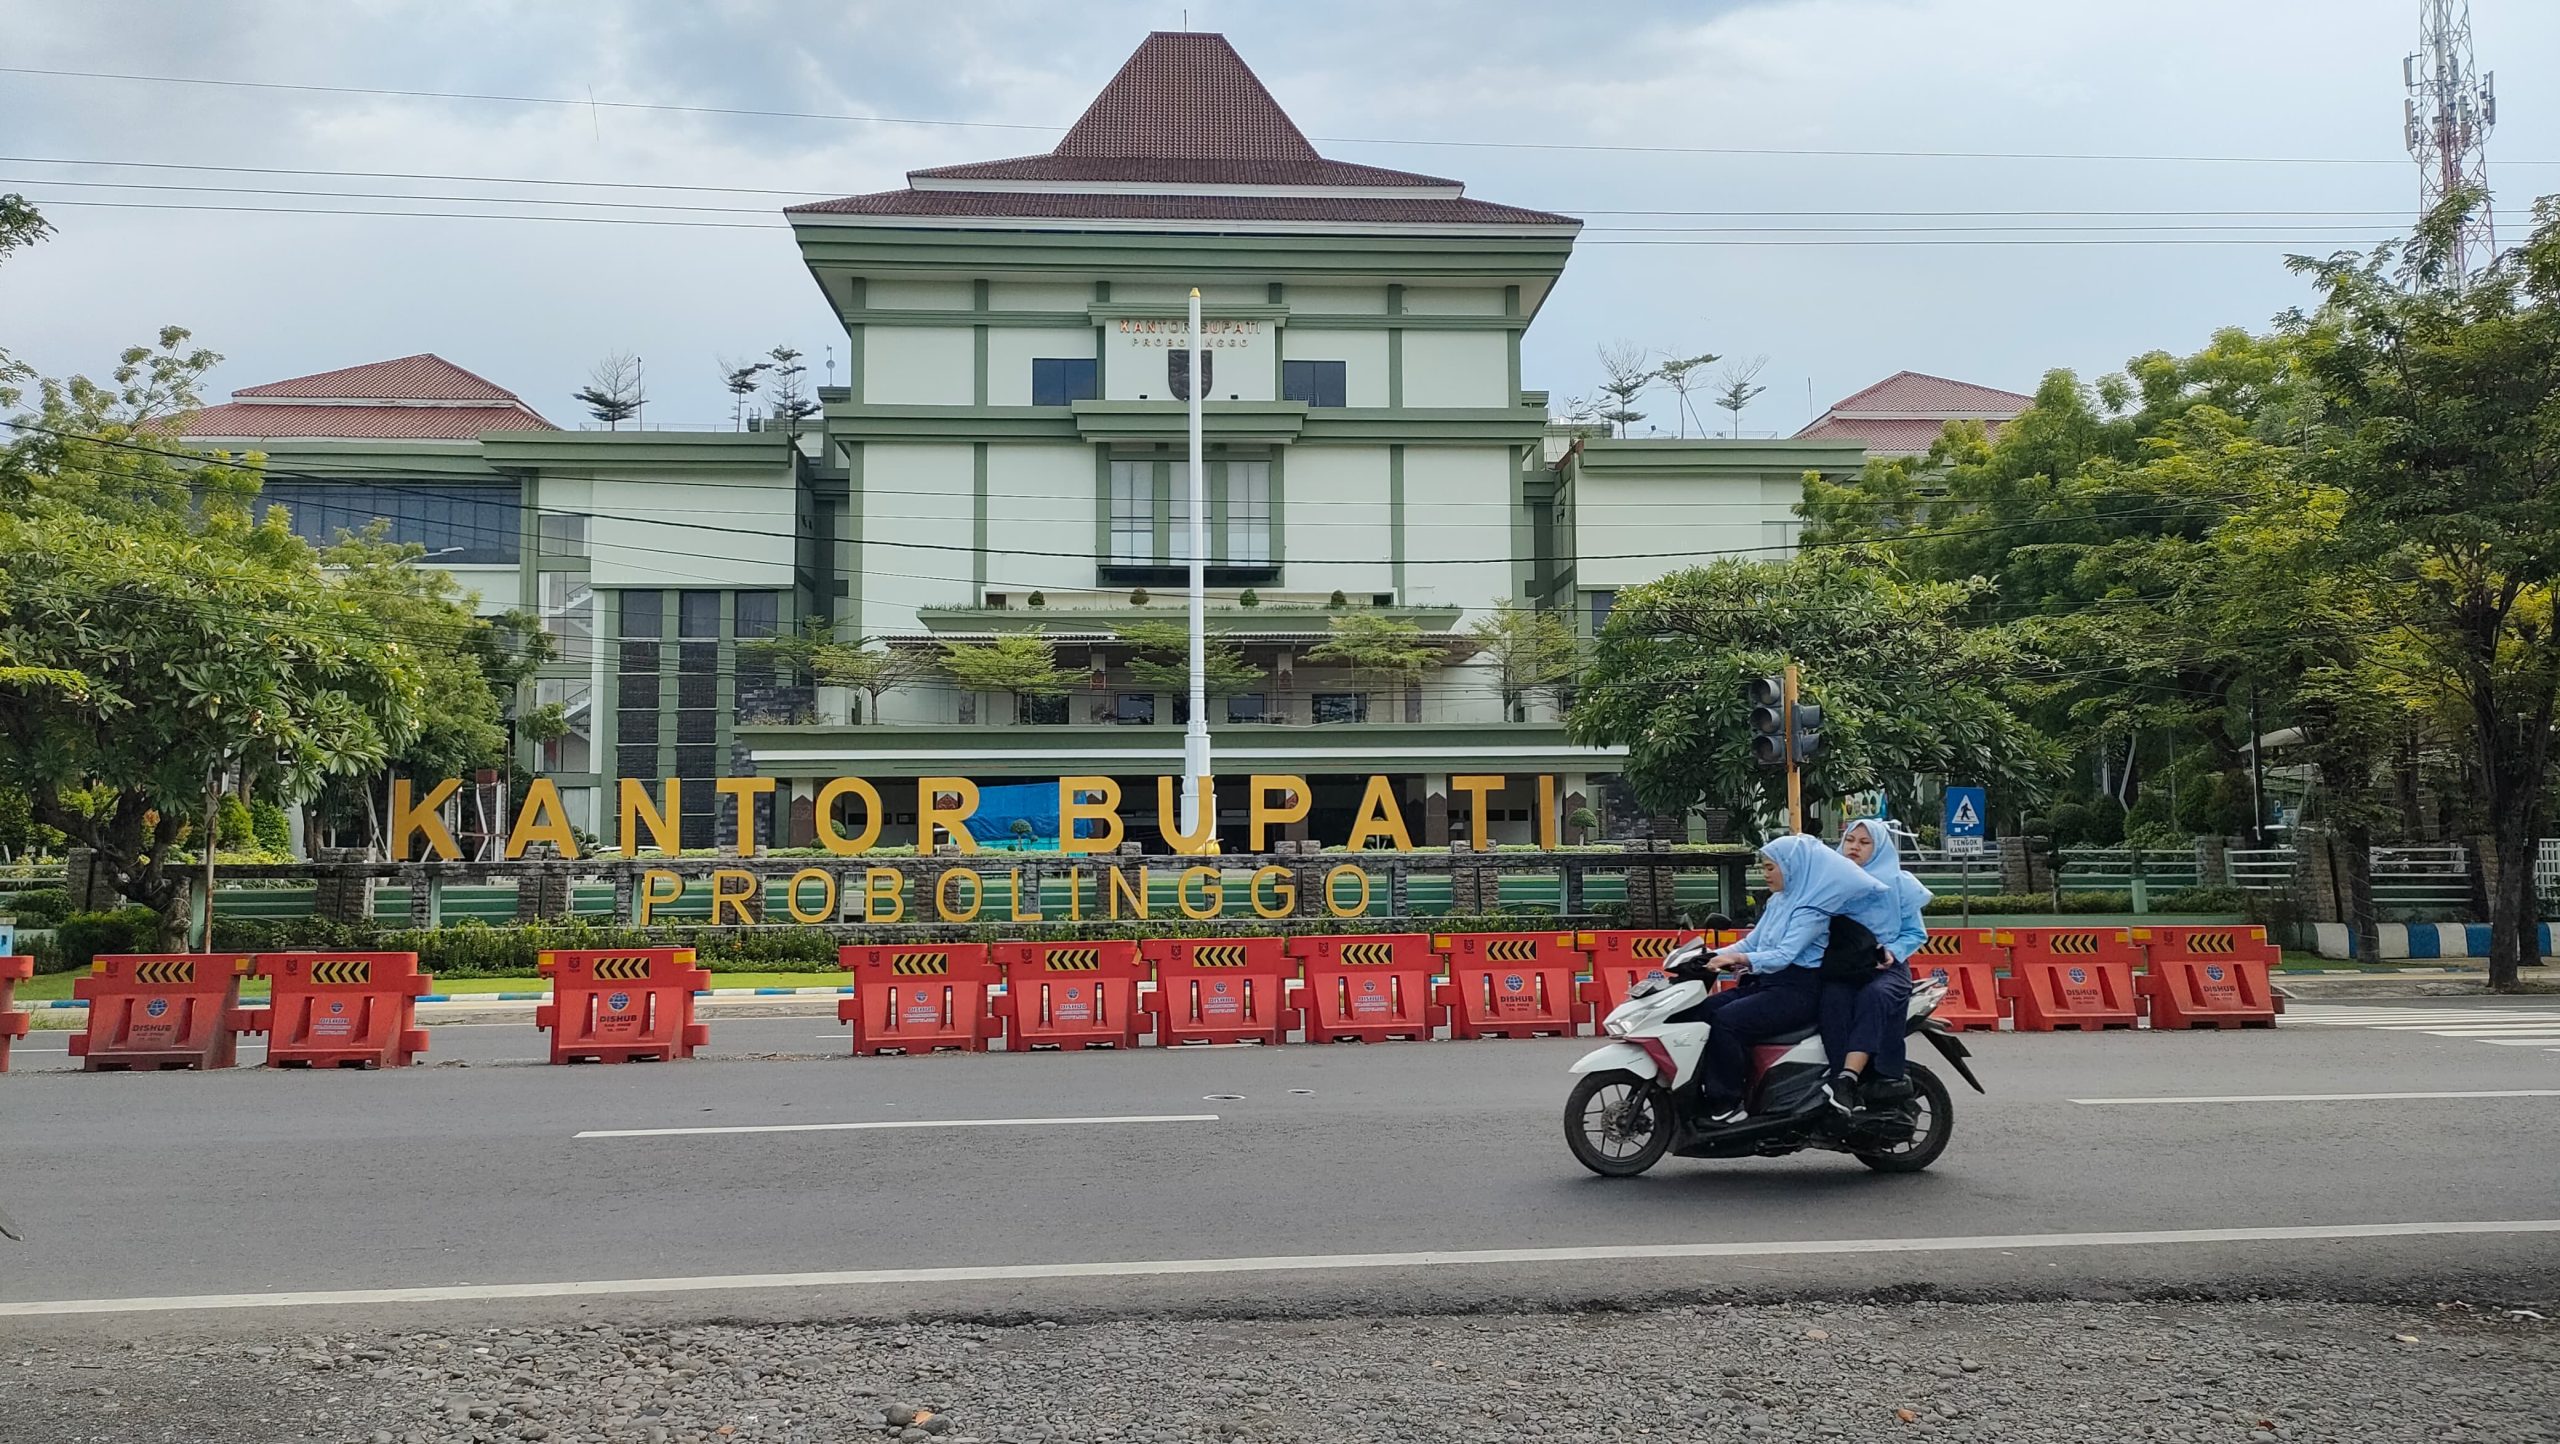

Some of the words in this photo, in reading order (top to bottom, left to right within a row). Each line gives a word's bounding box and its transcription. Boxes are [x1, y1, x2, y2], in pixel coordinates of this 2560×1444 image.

[1119, 319, 1190, 334] KANTOR
[1132, 338, 1249, 348] PROBONGGO
[391, 776, 980, 860] KANTOR
[1059, 775, 1556, 854] BUPATI
[640, 864, 1370, 926] PROBOLINGGO
